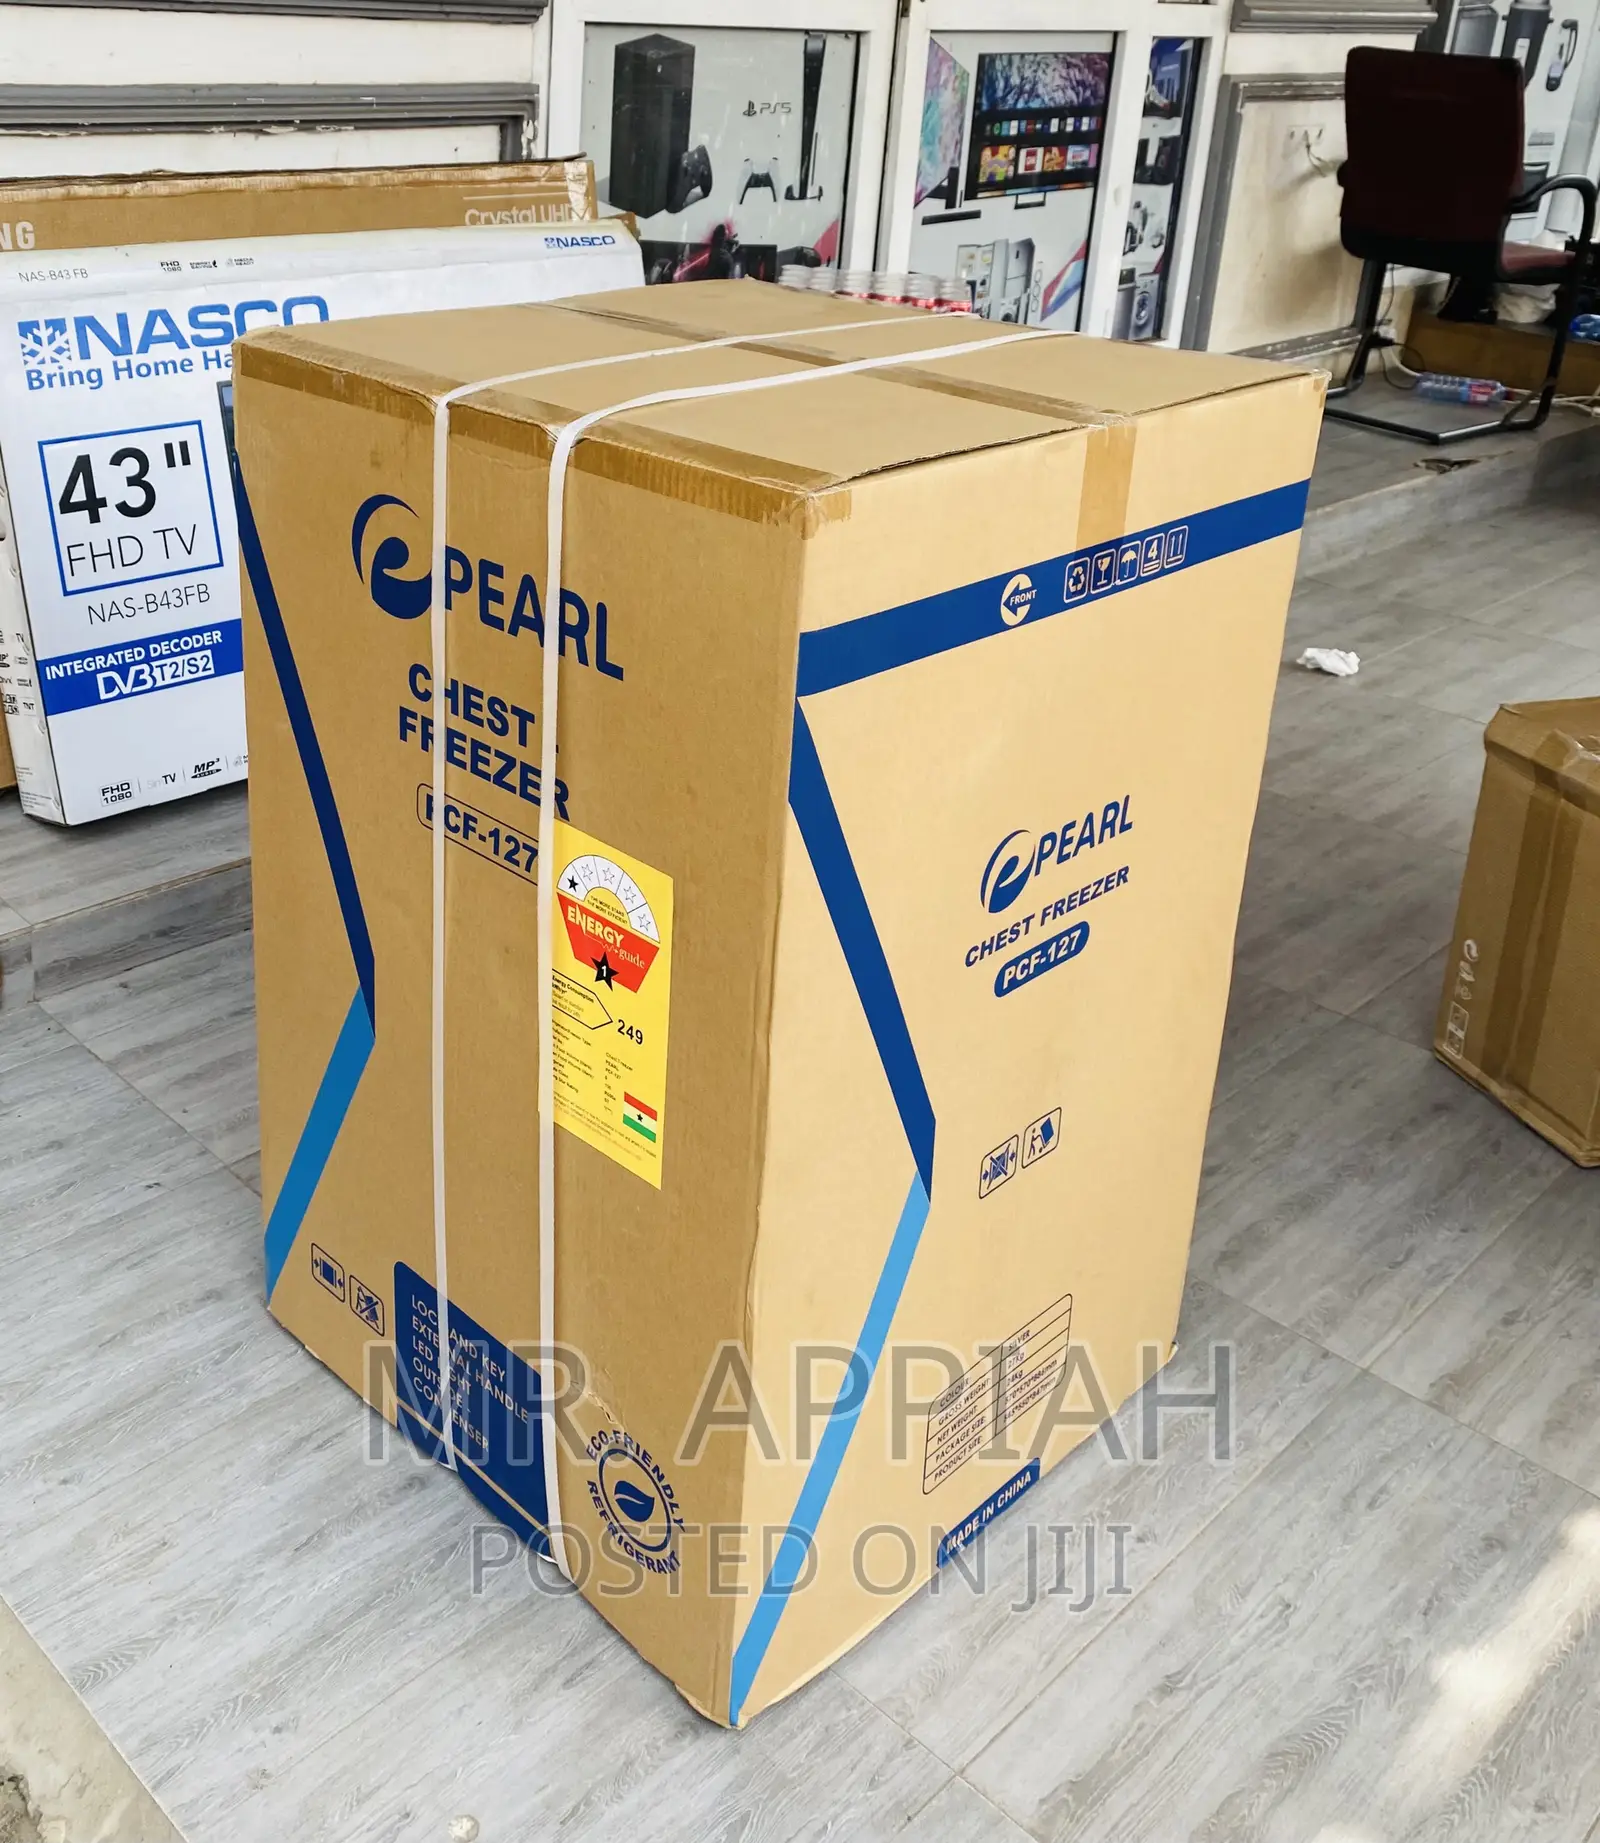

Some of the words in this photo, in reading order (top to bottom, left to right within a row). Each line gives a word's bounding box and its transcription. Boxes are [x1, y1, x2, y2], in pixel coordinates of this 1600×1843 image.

[760, 102, 791, 114] PS5
[556, 235, 616, 248] NASCO
[26, 365, 103, 390] Bring
[112, 357, 194, 381] Home
[58, 440, 191, 524] 43"
[66, 535, 144, 576] FHD
[153, 524, 197, 559] TV
[87, 583, 211, 625] NAS-B43FB
[444, 545, 623, 681] PEARL
[1009, 589, 1037, 606] FRONT
[45, 647, 145, 680] INTEGRATED
[149, 630, 223, 658] DECODER
[101, 782, 131, 796] FHD
[103, 791, 132, 804] 1080
[1034, 794, 1133, 877] PEARL
[567, 904, 624, 947] ENERGY
[965, 913, 1035, 967] CHEST
[1040, 866, 1129, 926] FREEZER
[601, 965, 607, 977] 1
[618, 948, 646, 969] guide
[1002, 929, 1082, 990] PCF-127
[617, 1019, 644, 1045] 249
[411, 1294, 438, 1326] LOC
[449, 1327, 478, 1359] AND
[482, 1354, 506, 1383] KEY
[1008, 1329, 1030, 1352] SILVER
[412, 1335, 433, 1361] LED
[438, 1356, 472, 1396] LGHT
[412, 1315, 471, 1375] EXTENAL
[475, 1369, 528, 1424] HANDLE
[413, 1356, 463, 1408] OUTSDE
[413, 1377, 489, 1453] CONENSER
[938, 1401, 962, 1425] GROSS
[935, 1429, 970, 1463] PACKAGE
[937, 1428, 950, 1445] NET
[586, 1429, 686, 1532] ECO-FRIENDLY
[933, 1449, 967, 1482] PRODUCT
[587, 1480, 681, 1574] REFRIGERANT
[946, 1515, 980, 1554] MADE
[982, 1502, 995, 1522] IN
[997, 1471, 1031, 1508] CHINA
